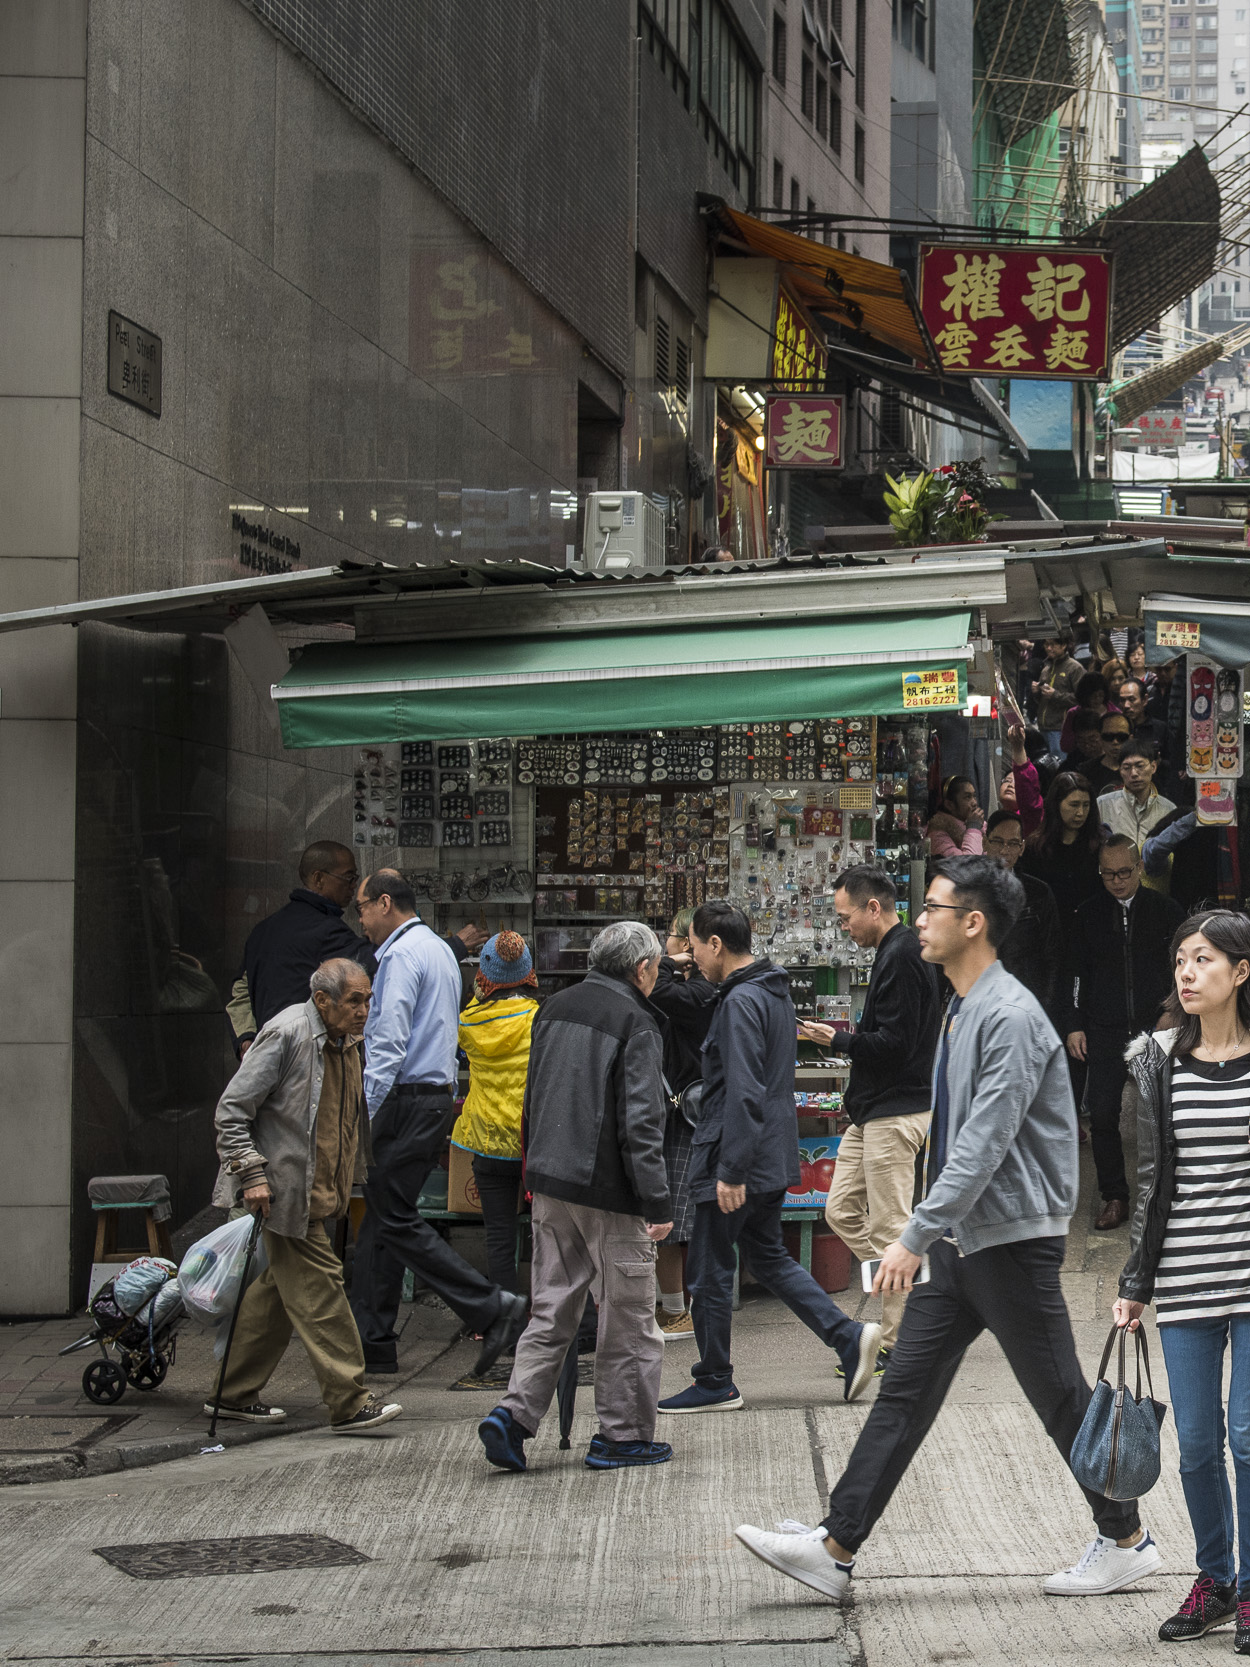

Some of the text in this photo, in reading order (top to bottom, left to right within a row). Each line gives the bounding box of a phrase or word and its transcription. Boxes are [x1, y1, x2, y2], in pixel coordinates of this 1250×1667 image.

[939, 253, 1091, 323] 權記
[136, 335, 157, 366] Street
[906, 685, 956, 697] 帆布工程
[906, 696, 956, 706] 2816 2727
